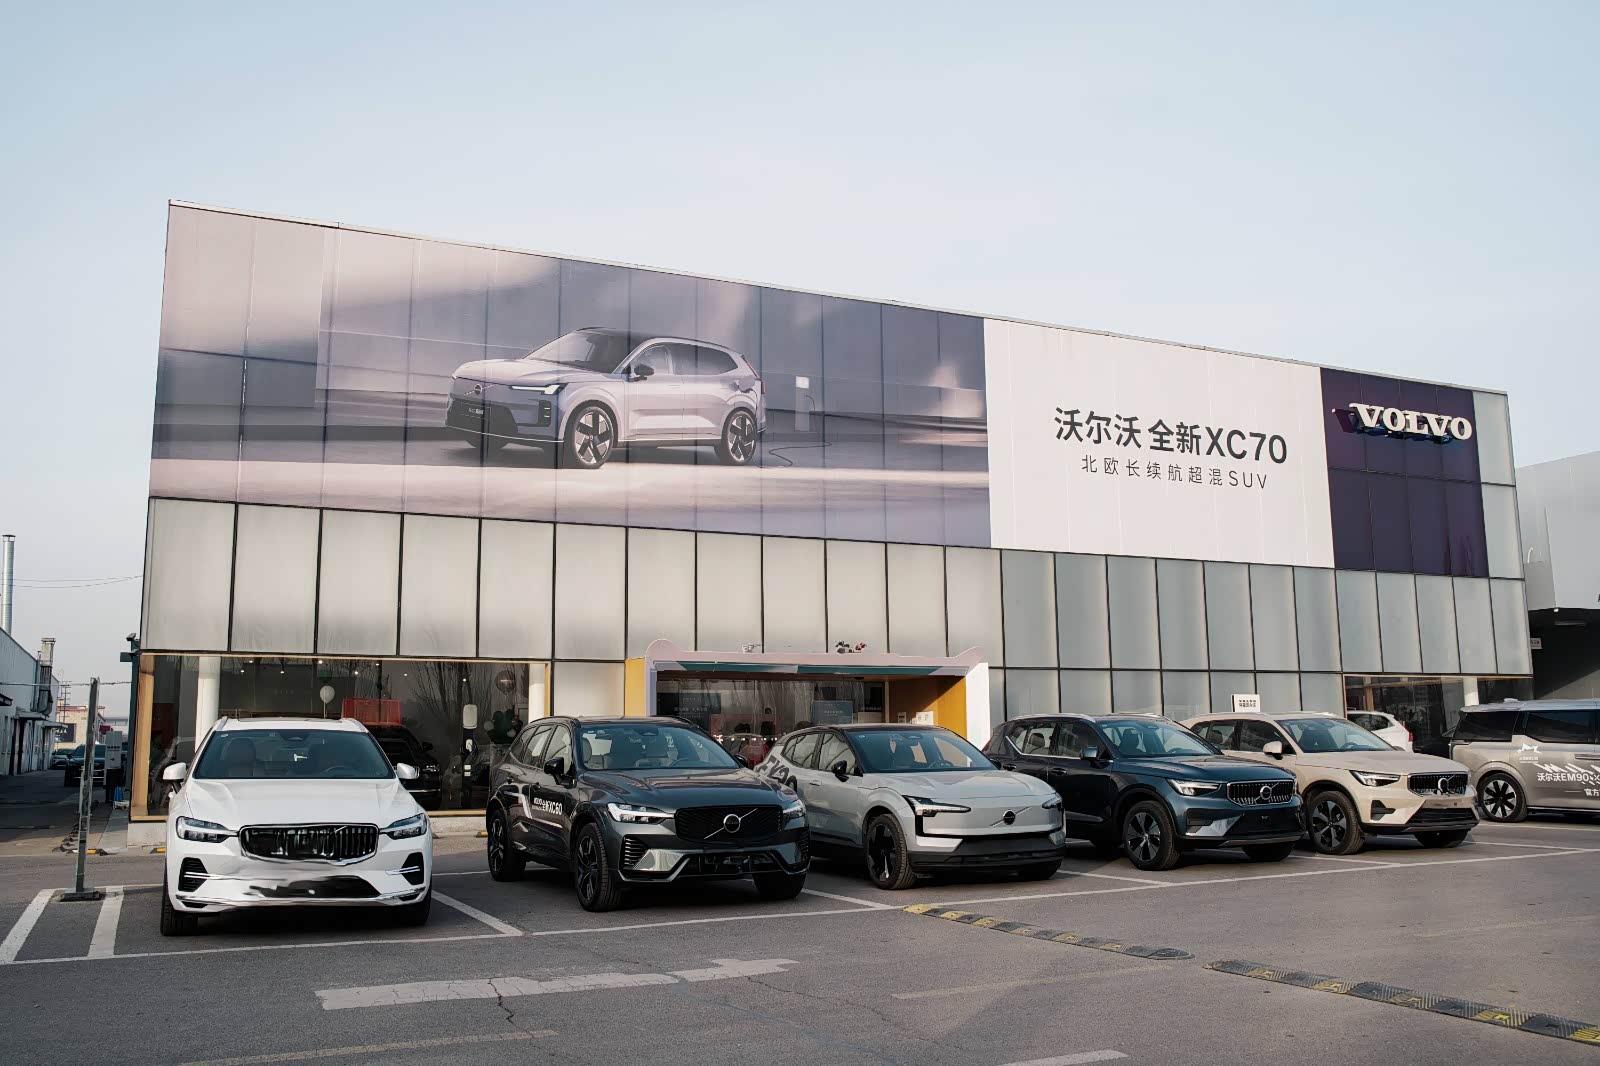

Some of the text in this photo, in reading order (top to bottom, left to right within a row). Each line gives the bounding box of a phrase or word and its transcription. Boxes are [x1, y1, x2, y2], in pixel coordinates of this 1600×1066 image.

[1054, 406, 1287, 464] 沃尔沃 全新XC70
[1349, 402, 1472, 440] VOLVO
[1081, 454, 1267, 489] 北欧长续航超混SUV
